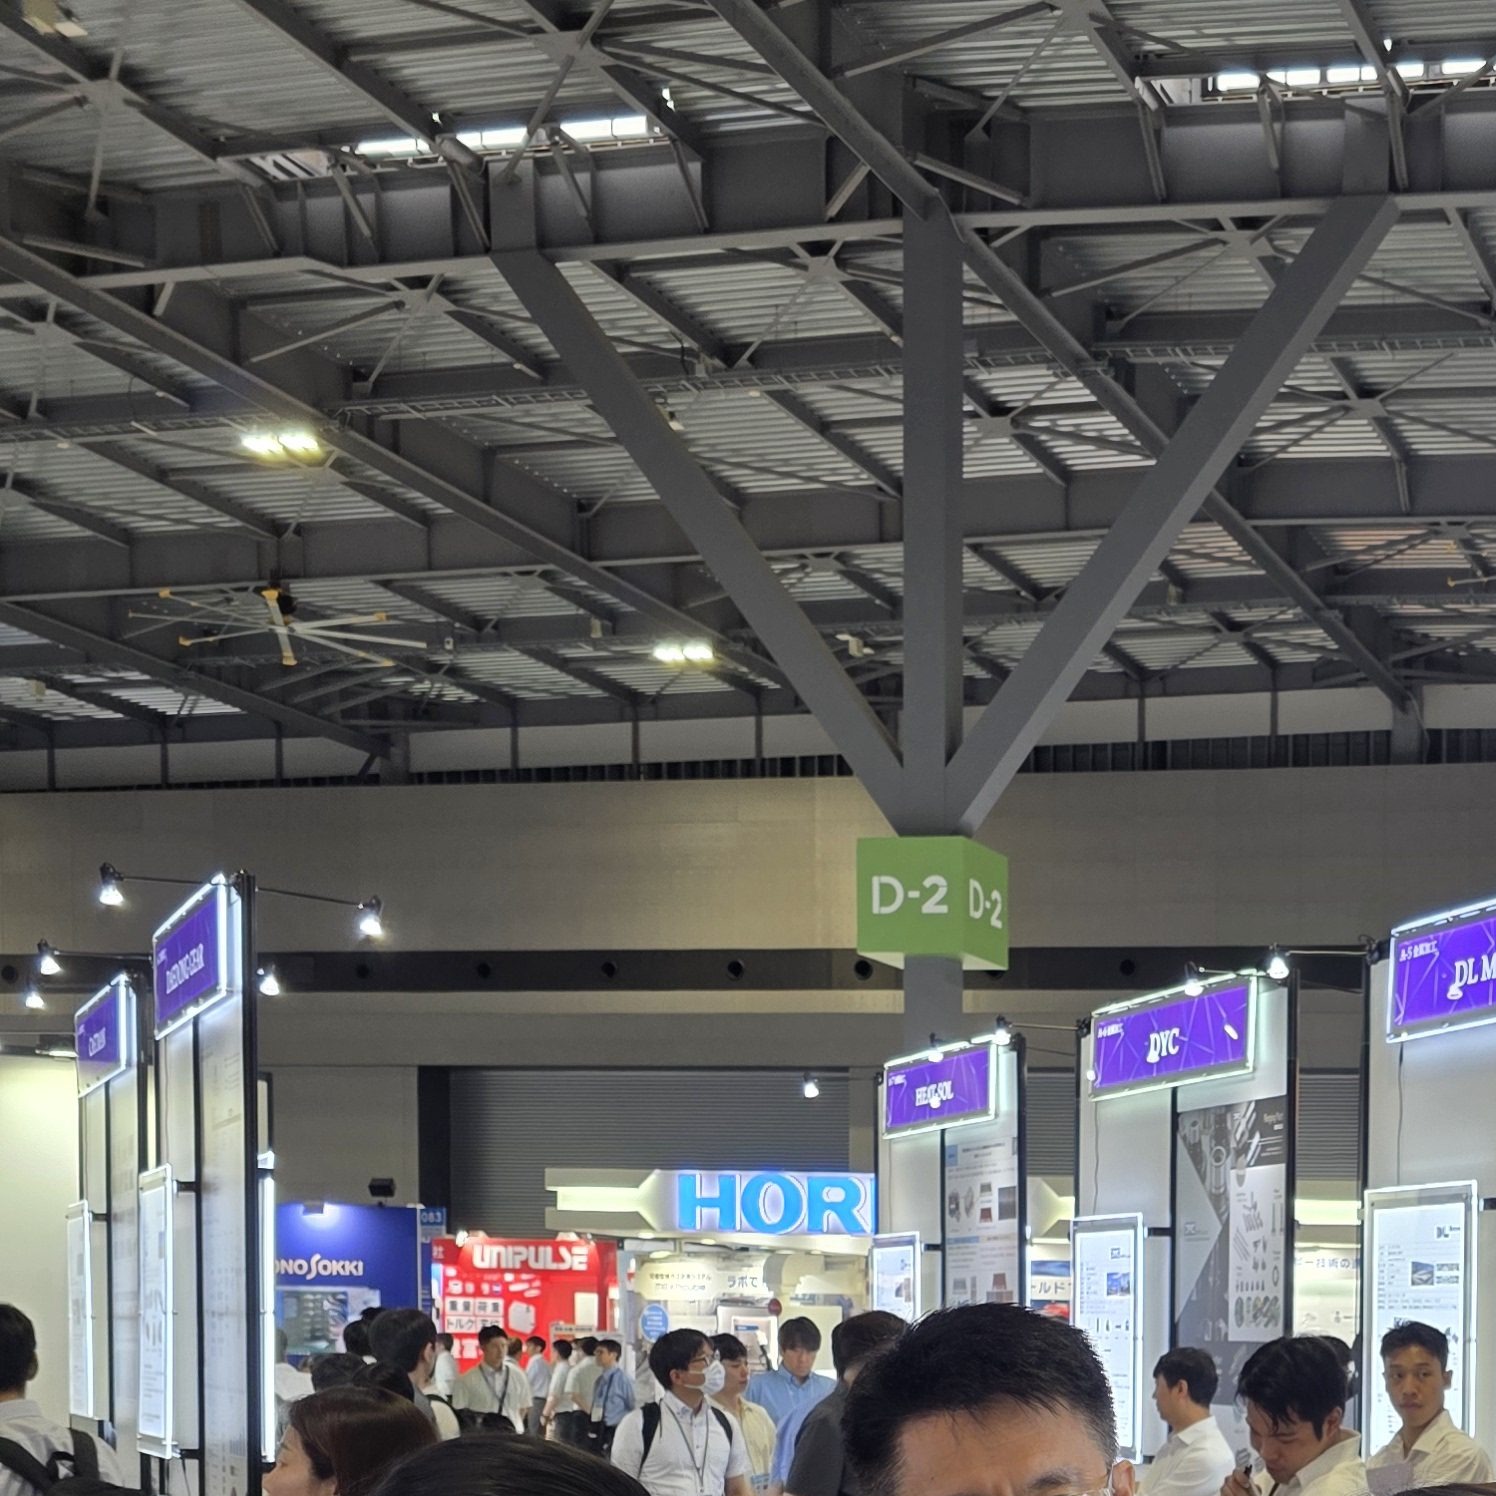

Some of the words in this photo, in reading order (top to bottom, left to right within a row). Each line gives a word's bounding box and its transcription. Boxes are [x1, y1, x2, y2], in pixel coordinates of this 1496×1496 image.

[871, 875, 949, 915] D-2
[968, 879, 1002, 929] D-2
[1149, 1027, 1180, 1058] DYC
[678, 1173, 875, 1235] HOR
[472, 1244, 589, 1271] UNIPULSE
